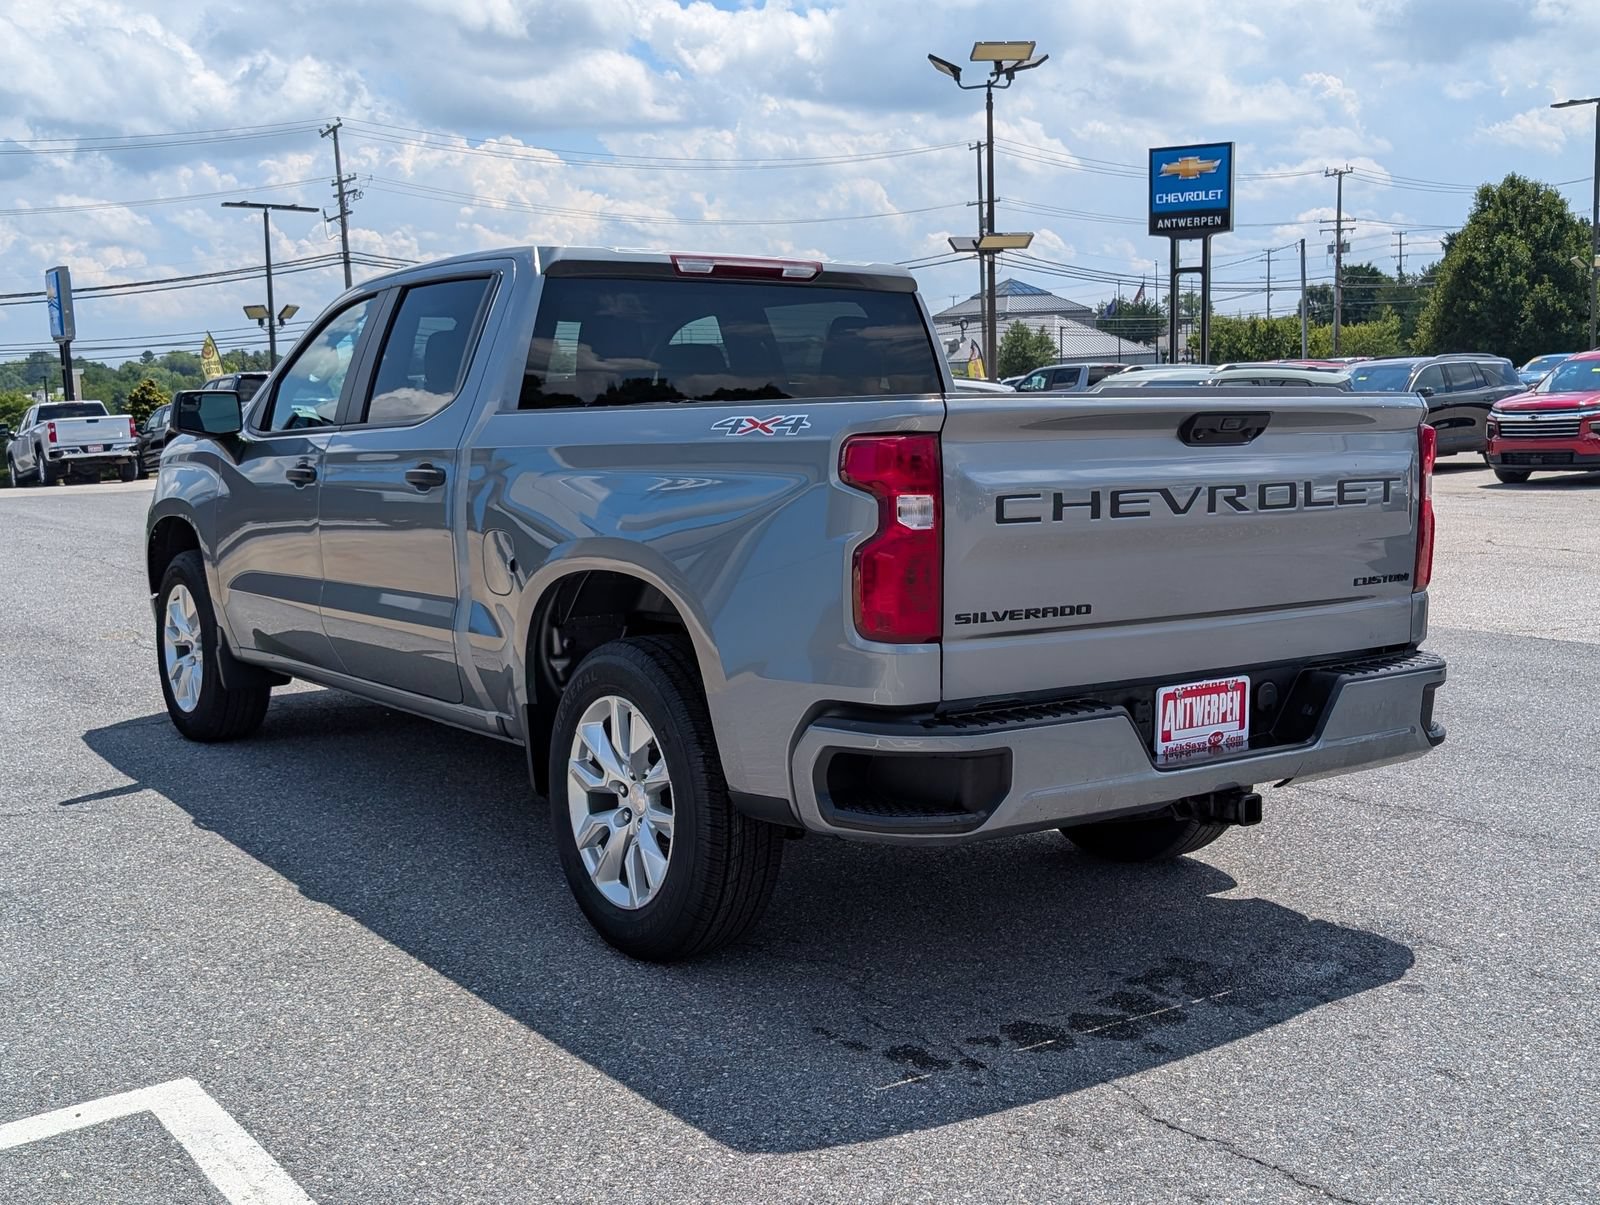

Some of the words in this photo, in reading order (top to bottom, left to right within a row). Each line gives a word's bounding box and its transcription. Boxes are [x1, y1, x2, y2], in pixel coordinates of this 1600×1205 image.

[1156, 190, 1223, 204] CHEVROLET
[1157, 215, 1222, 229] ANTWERPEN
[995, 477, 1400, 525] CHEVROLET
[1353, 572, 1410, 587] CUSTOM
[954, 603, 1093, 626] SILVERADO
[1163, 691, 1240, 731] ANTWERPEN
